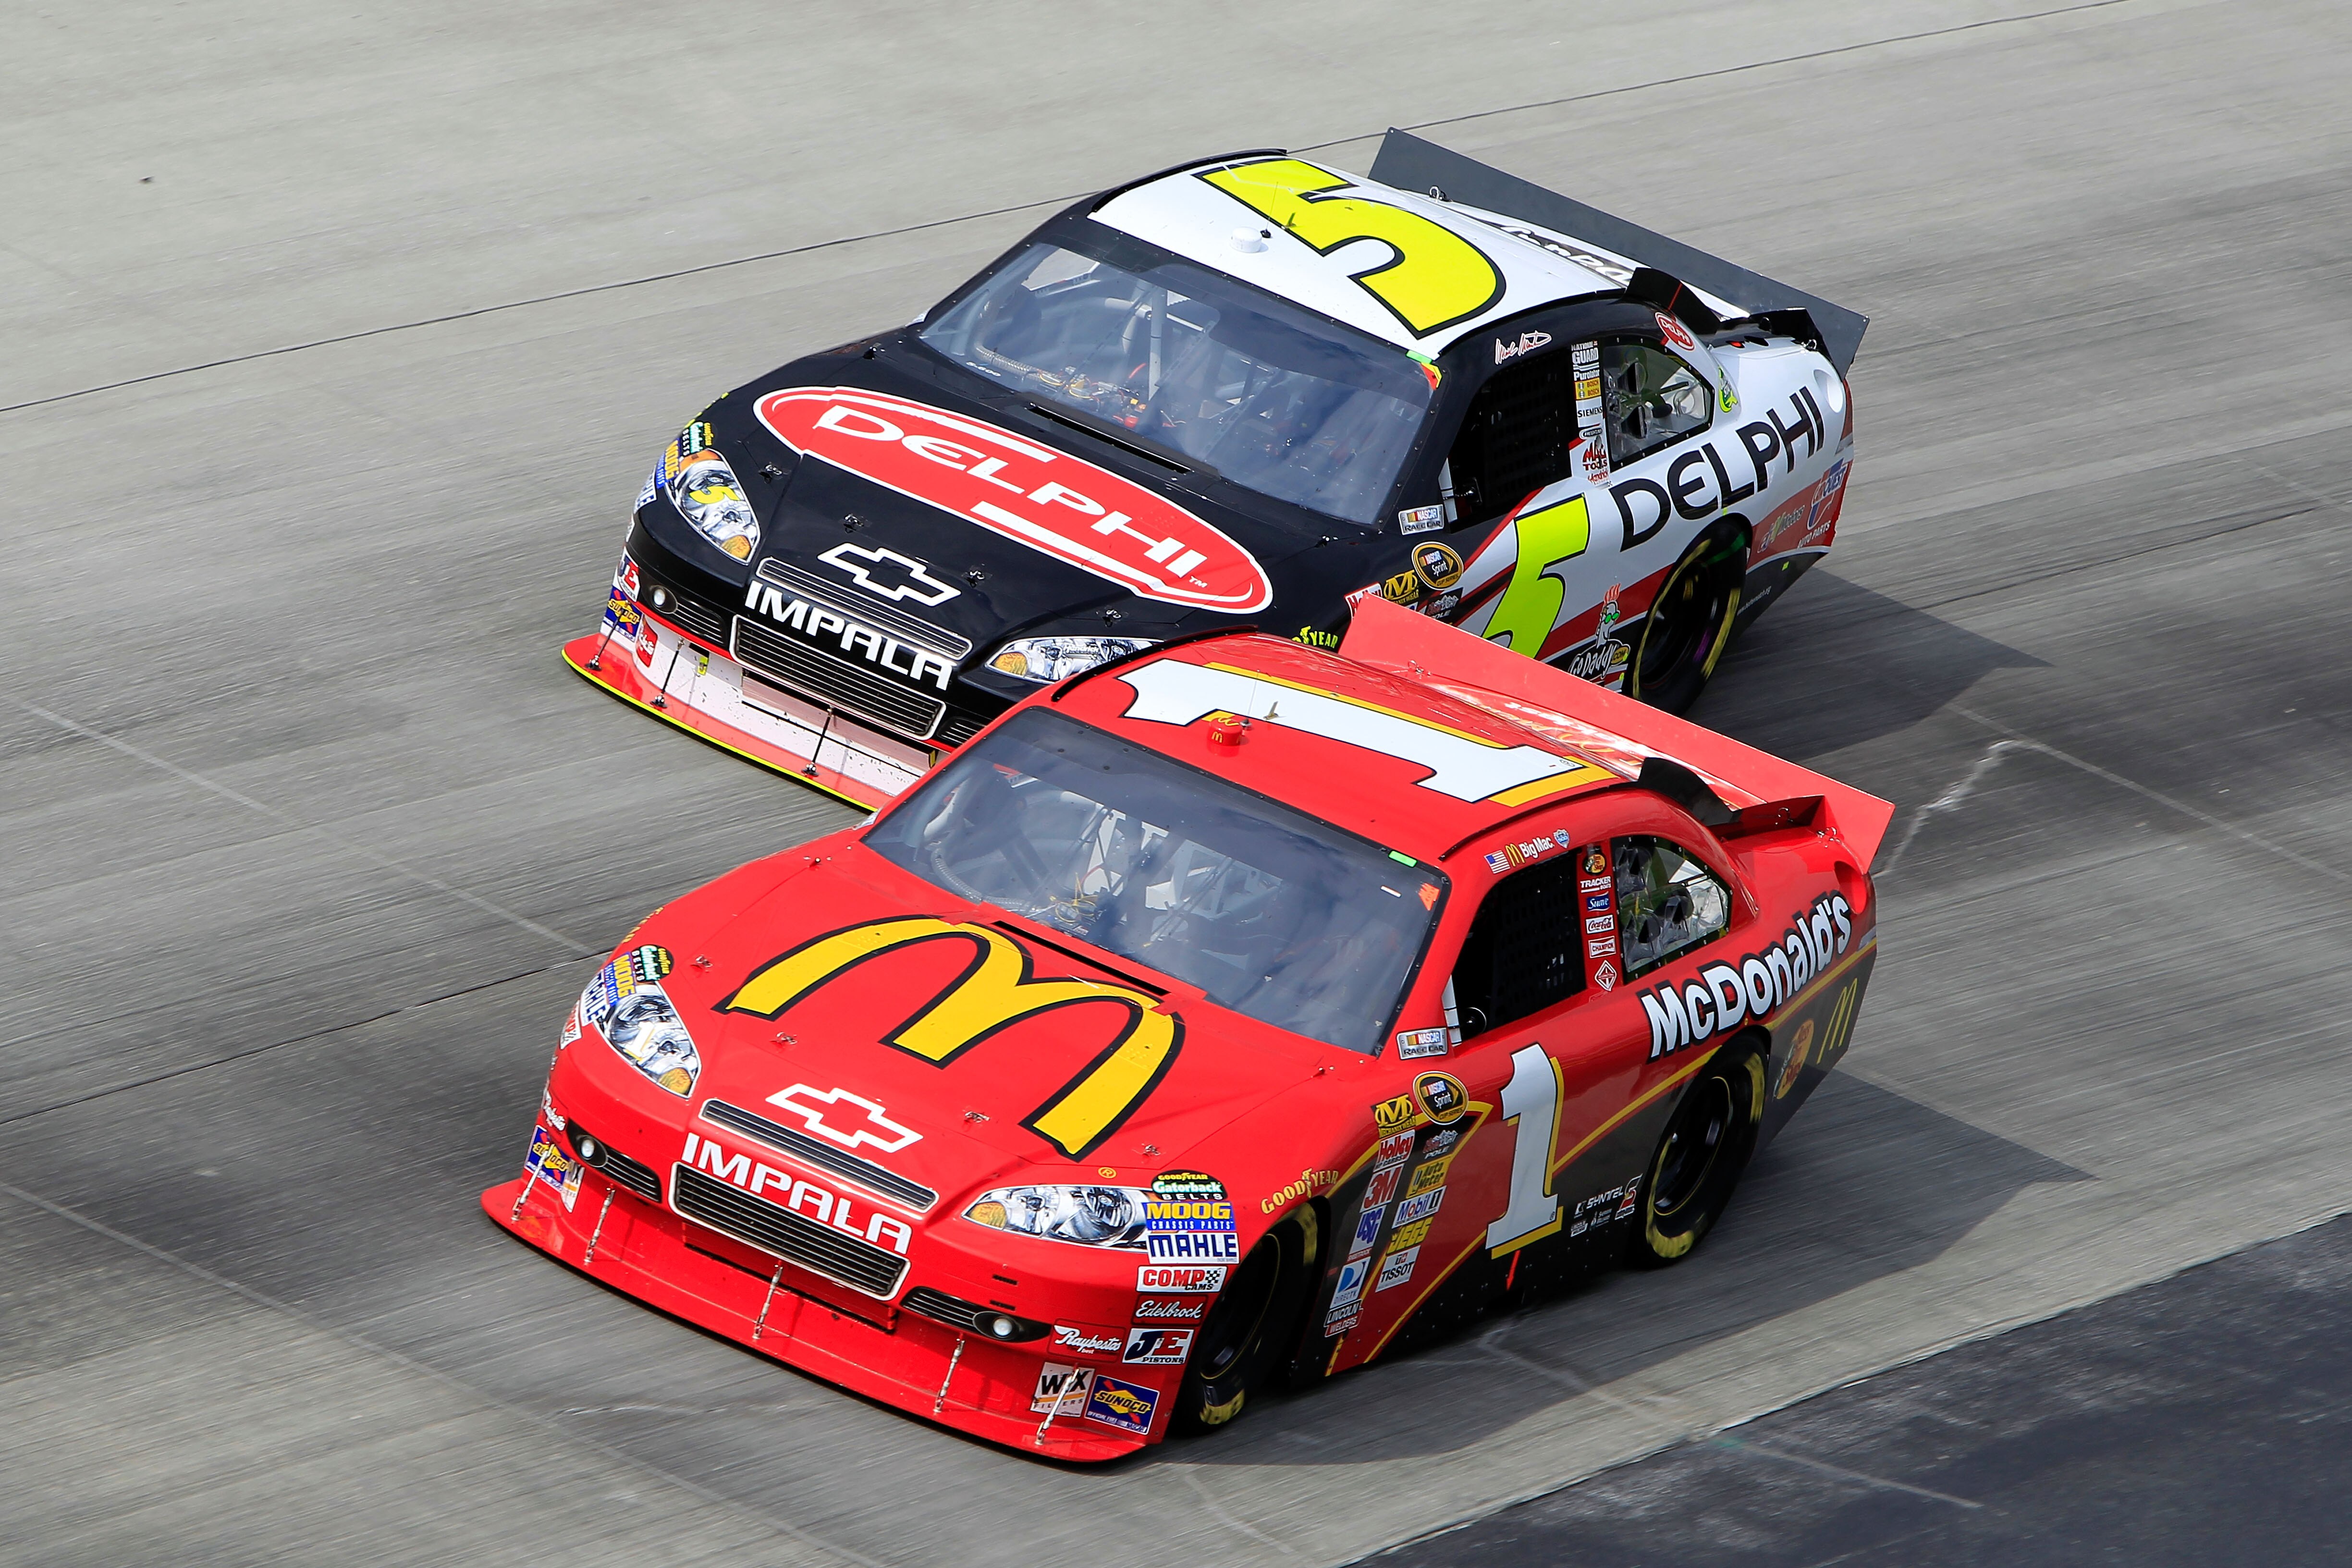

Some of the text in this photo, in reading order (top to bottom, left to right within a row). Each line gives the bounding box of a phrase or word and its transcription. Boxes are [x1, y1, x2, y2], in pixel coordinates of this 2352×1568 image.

[1191, 158, 1506, 339] 5
[1572, 347, 1599, 365] GUARD
[1573, 369, 1600, 381] Purolator
[1587, 380, 1599, 388] BOSCH
[1587, 388, 1600, 396] BOSCH
[1578, 406, 1603, 418] SIEMENS
[1611, 386, 1824, 552] DELPHI
[812, 405, 1207, 577] DELPHI
[1418, 508, 1438, 521] NASCAR
[1404, 520, 1441, 531] RACE CAR
[1425, 551, 1442, 565] NASCAR
[1432, 562, 1448, 576] Sprint
[745, 580, 953, 691] IMPALA
[1116, 659, 1584, 803] 1
[1519, 842, 1539, 858] Big
[1580, 876, 1611, 888] TRACKER
[1588, 897, 1609, 909] Suave
[631, 950, 646, 981] BELTS
[612, 954, 636, 998] MOOG
[1641, 895, 1852, 1058] McDonald's
[1417, 1031, 1441, 1045] NASCAR
[1403, 1044, 1445, 1055] RACE CAR
[1433, 1091, 1452, 1109] Sprint
[1377, 1136, 1414, 1161] Holley
[1425, 1146, 1449, 1159] POLE
[1485, 1043, 1558, 1250] 1
[1158, 1172, 1209, 1181] GOODYEAR
[1424, 1162, 1444, 1176] Auto
[1152, 1181, 1223, 1194] Gatorback
[1363, 1165, 1402, 1210] 3M
[1419, 1172, 1444, 1188] Meter
[681, 1132, 913, 1254] IMPALA
[1261, 1168, 1339, 1214] GOODYEAR
[1146, 1202, 1231, 1220] MOOG
[1397, 1193, 1431, 1222] Mobil
[1151, 1221, 1231, 1230] CHASSIS PARTS
[1148, 1234, 1237, 1257] MAHLE
[1142, 1269, 1206, 1287] COMP
[1381, 1261, 1415, 1283] TISSOT
[1135, 1300, 1204, 1319] Edelbrock
[1326, 1302, 1360, 1324] LINCOLN
[1329, 1315, 1358, 1334] WELDERS
[1124, 1330, 1190, 1361] JE
[1041, 1370, 1093, 1395] WX
[1033, 1398, 1083, 1409] FILERS
[1096, 1391, 1151, 1413] SUNOCO
